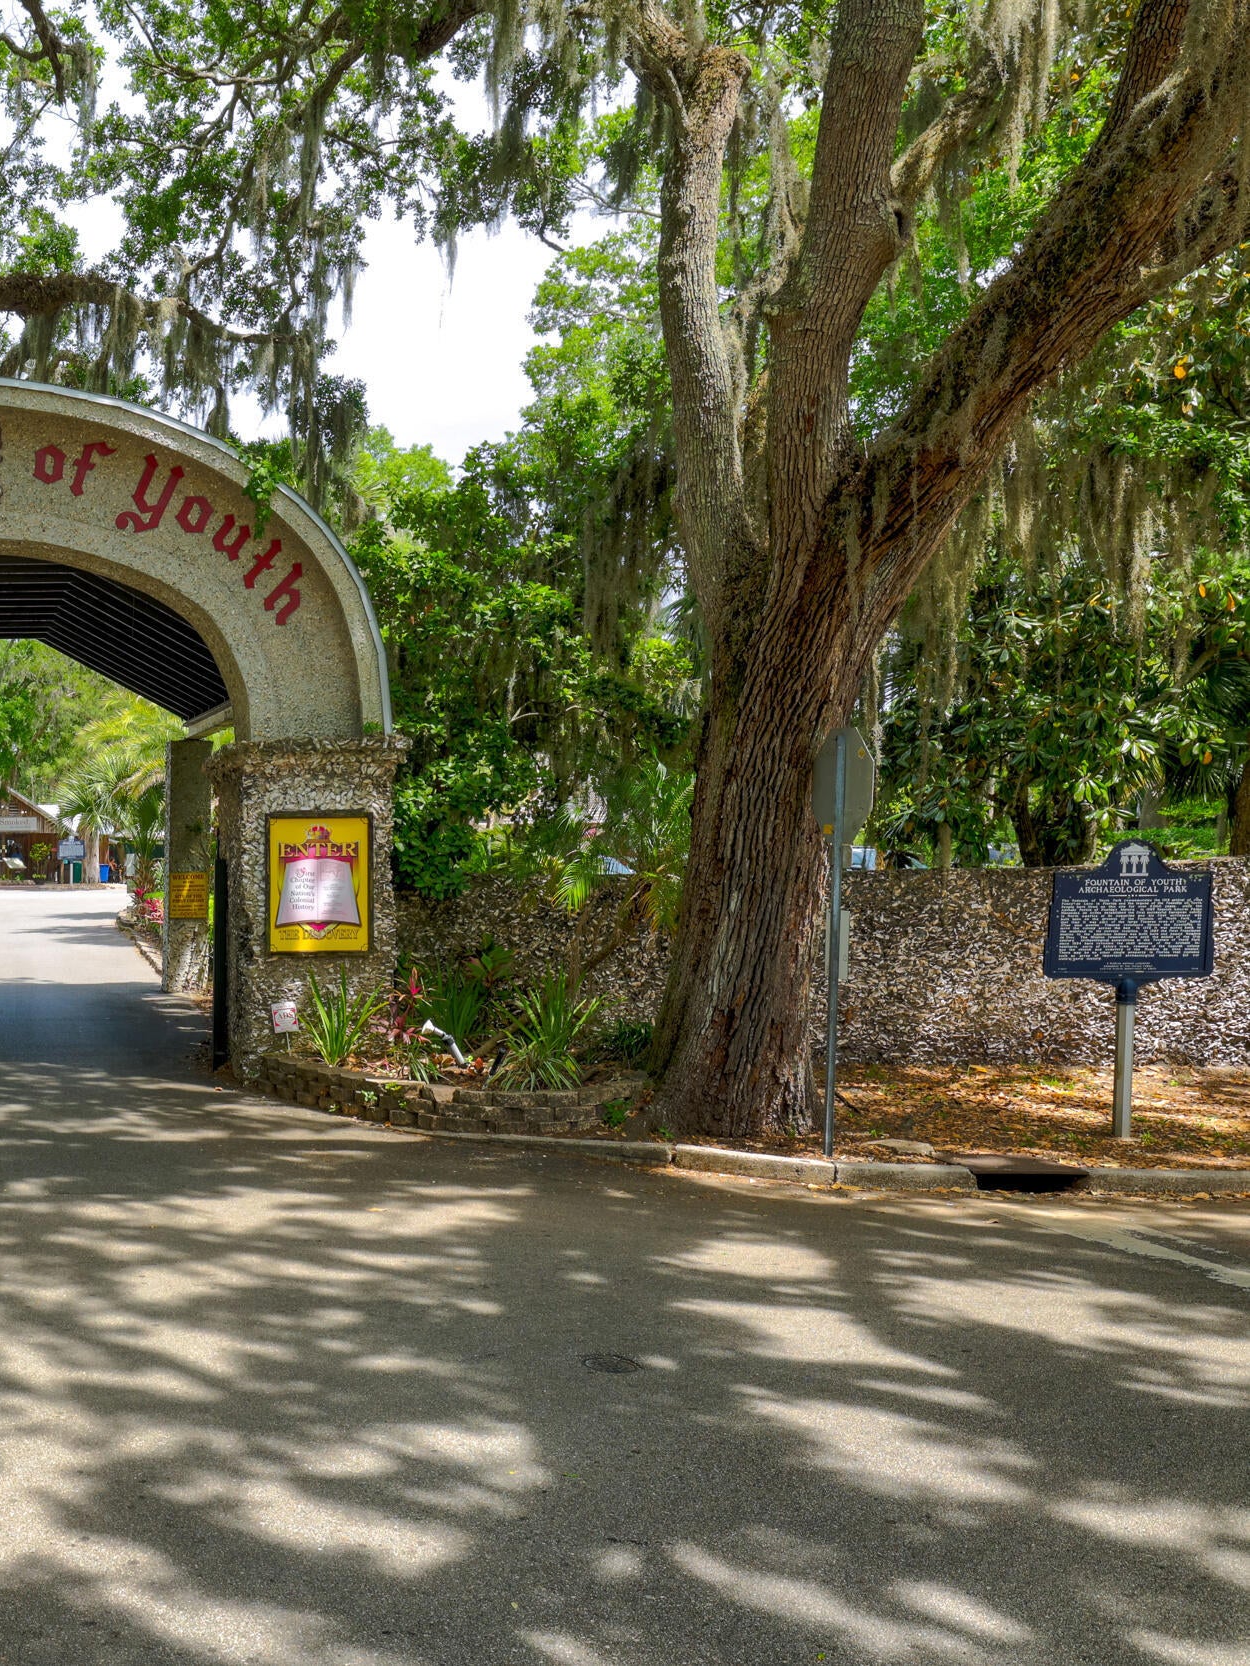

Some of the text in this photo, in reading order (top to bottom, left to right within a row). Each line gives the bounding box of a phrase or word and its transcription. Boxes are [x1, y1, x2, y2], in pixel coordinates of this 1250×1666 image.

[33, 441, 117, 497] of
[115, 453, 303, 626] Youth
[279, 842, 357, 857] ENTER
[290, 876, 315, 884] Chapter
[1085, 878, 1182, 886] FOUNTAIN OF YOUTH
[1163, 885, 1188, 893] PARK
[279, 929, 299, 940] THE
